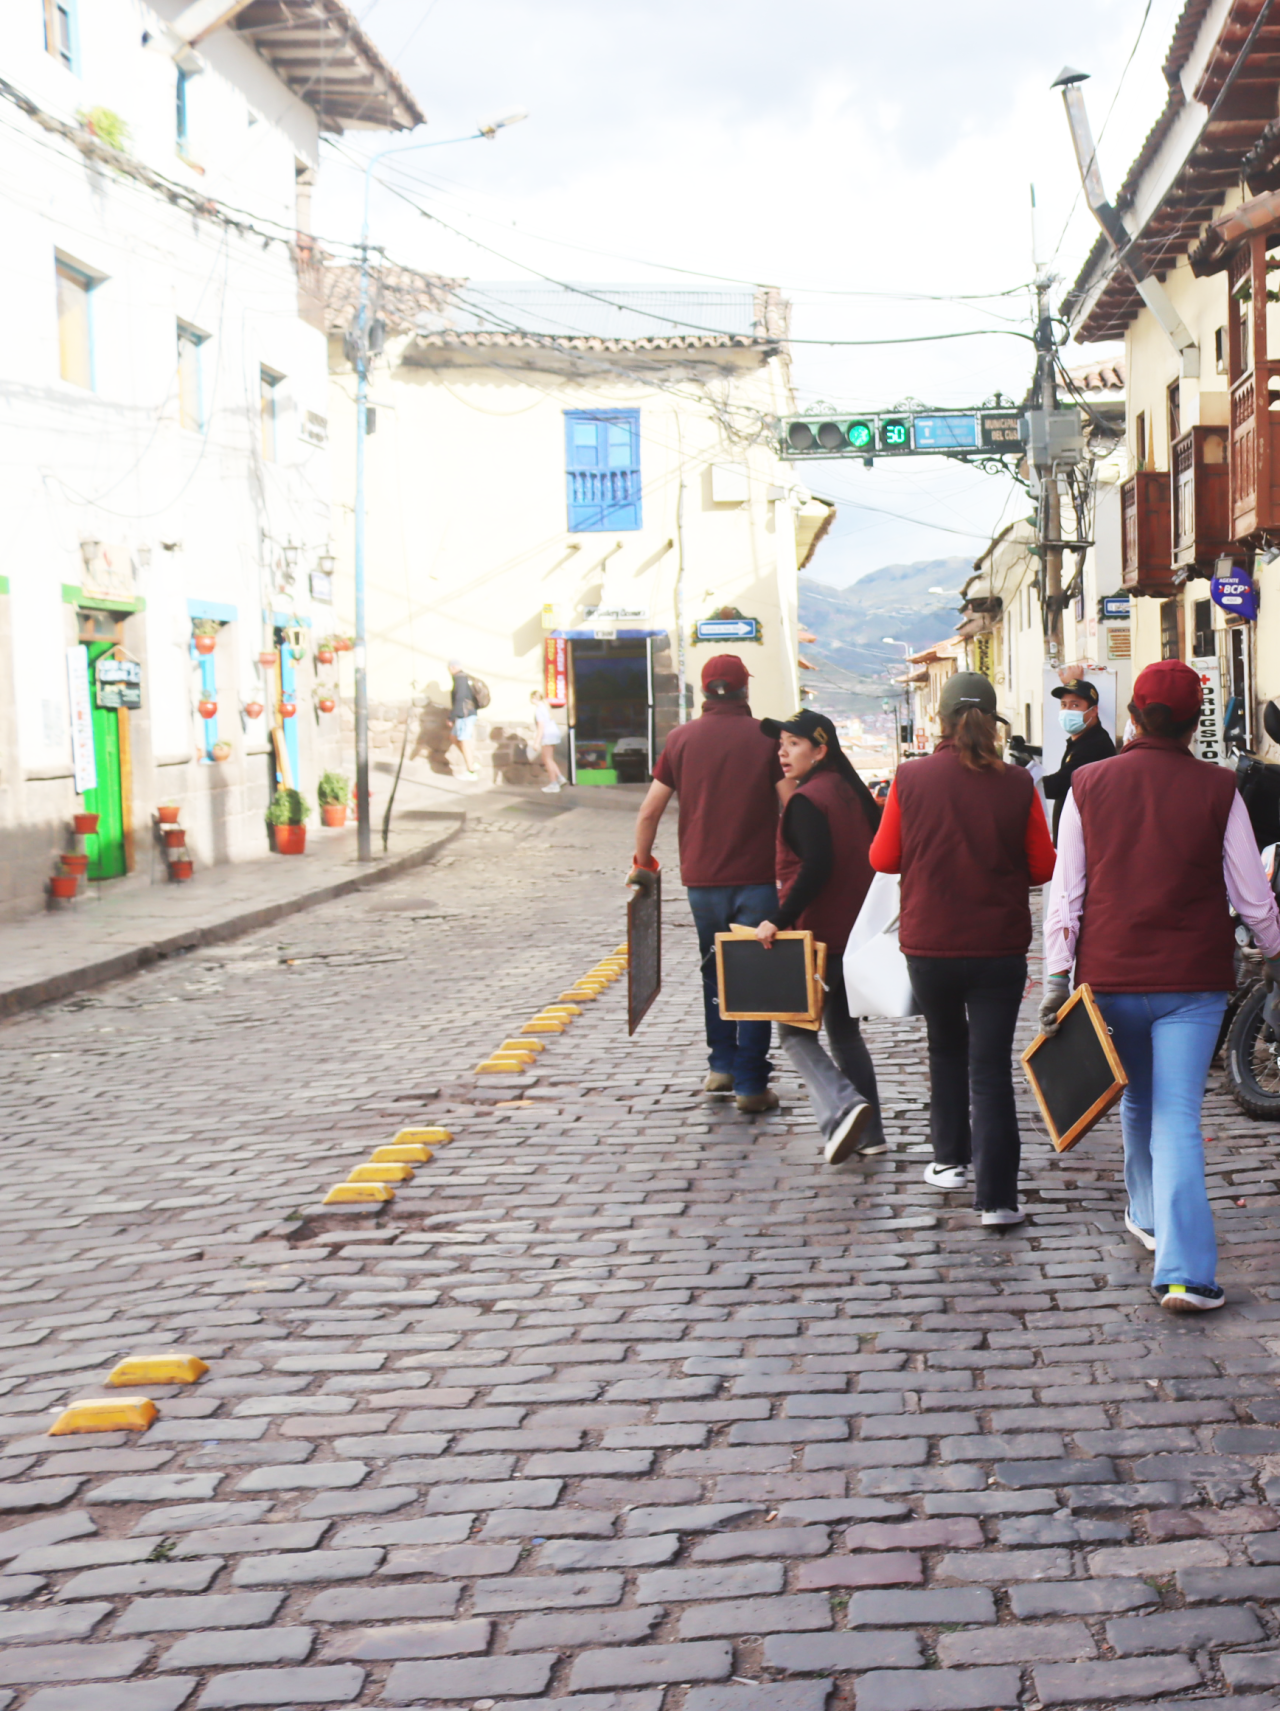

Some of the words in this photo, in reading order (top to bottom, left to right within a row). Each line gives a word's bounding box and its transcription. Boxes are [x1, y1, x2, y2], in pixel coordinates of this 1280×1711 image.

[1004, 430, 1018, 441] CUS
[1223, 584, 1245, 594] BCP
[1200, 686, 1219, 766] DRUGSTO
